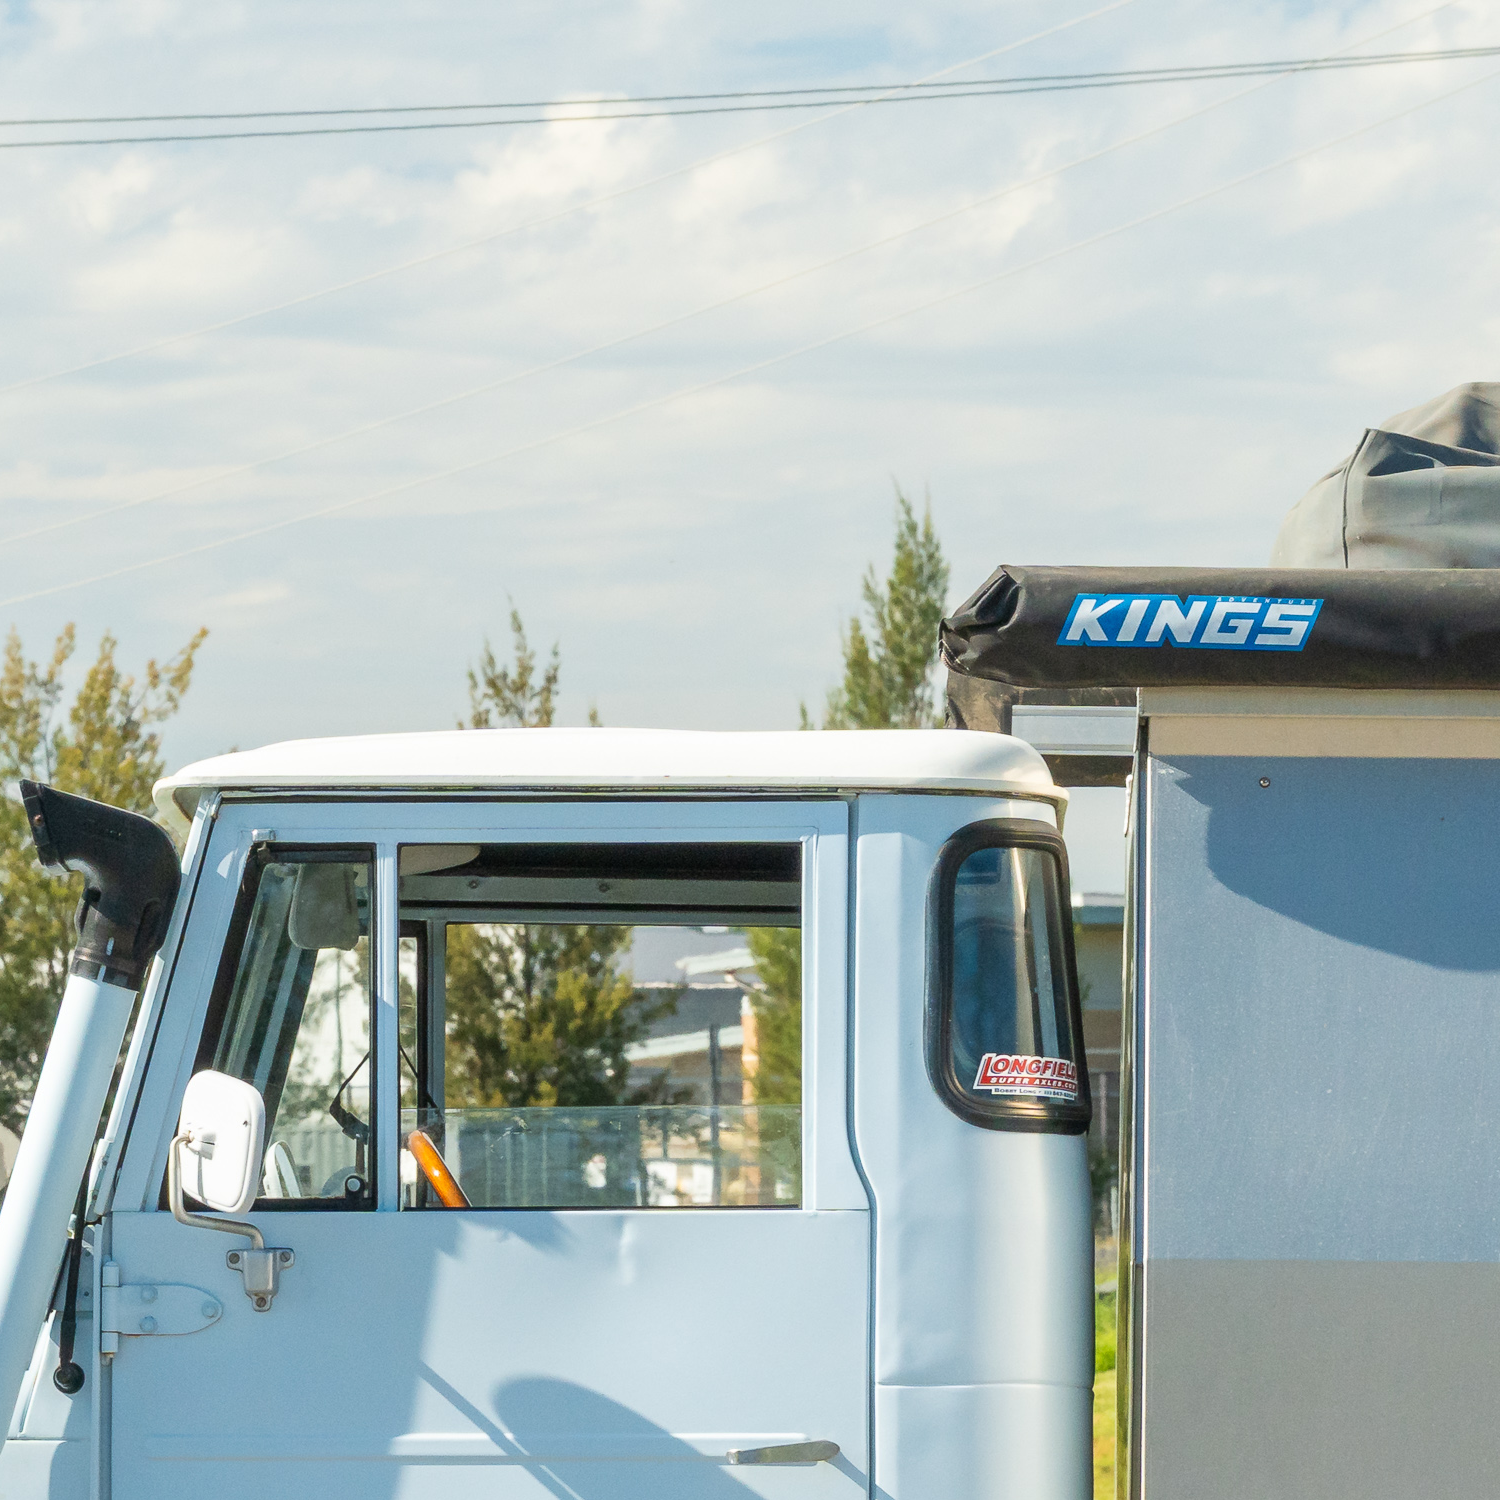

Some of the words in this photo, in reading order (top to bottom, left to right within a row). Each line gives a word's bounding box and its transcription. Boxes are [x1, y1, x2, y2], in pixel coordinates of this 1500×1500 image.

[1216, 596, 1319, 605] ADVENTURE
[1065, 598, 1317, 647] KINGS
[990, 1076, 1031, 1086] SUPER
